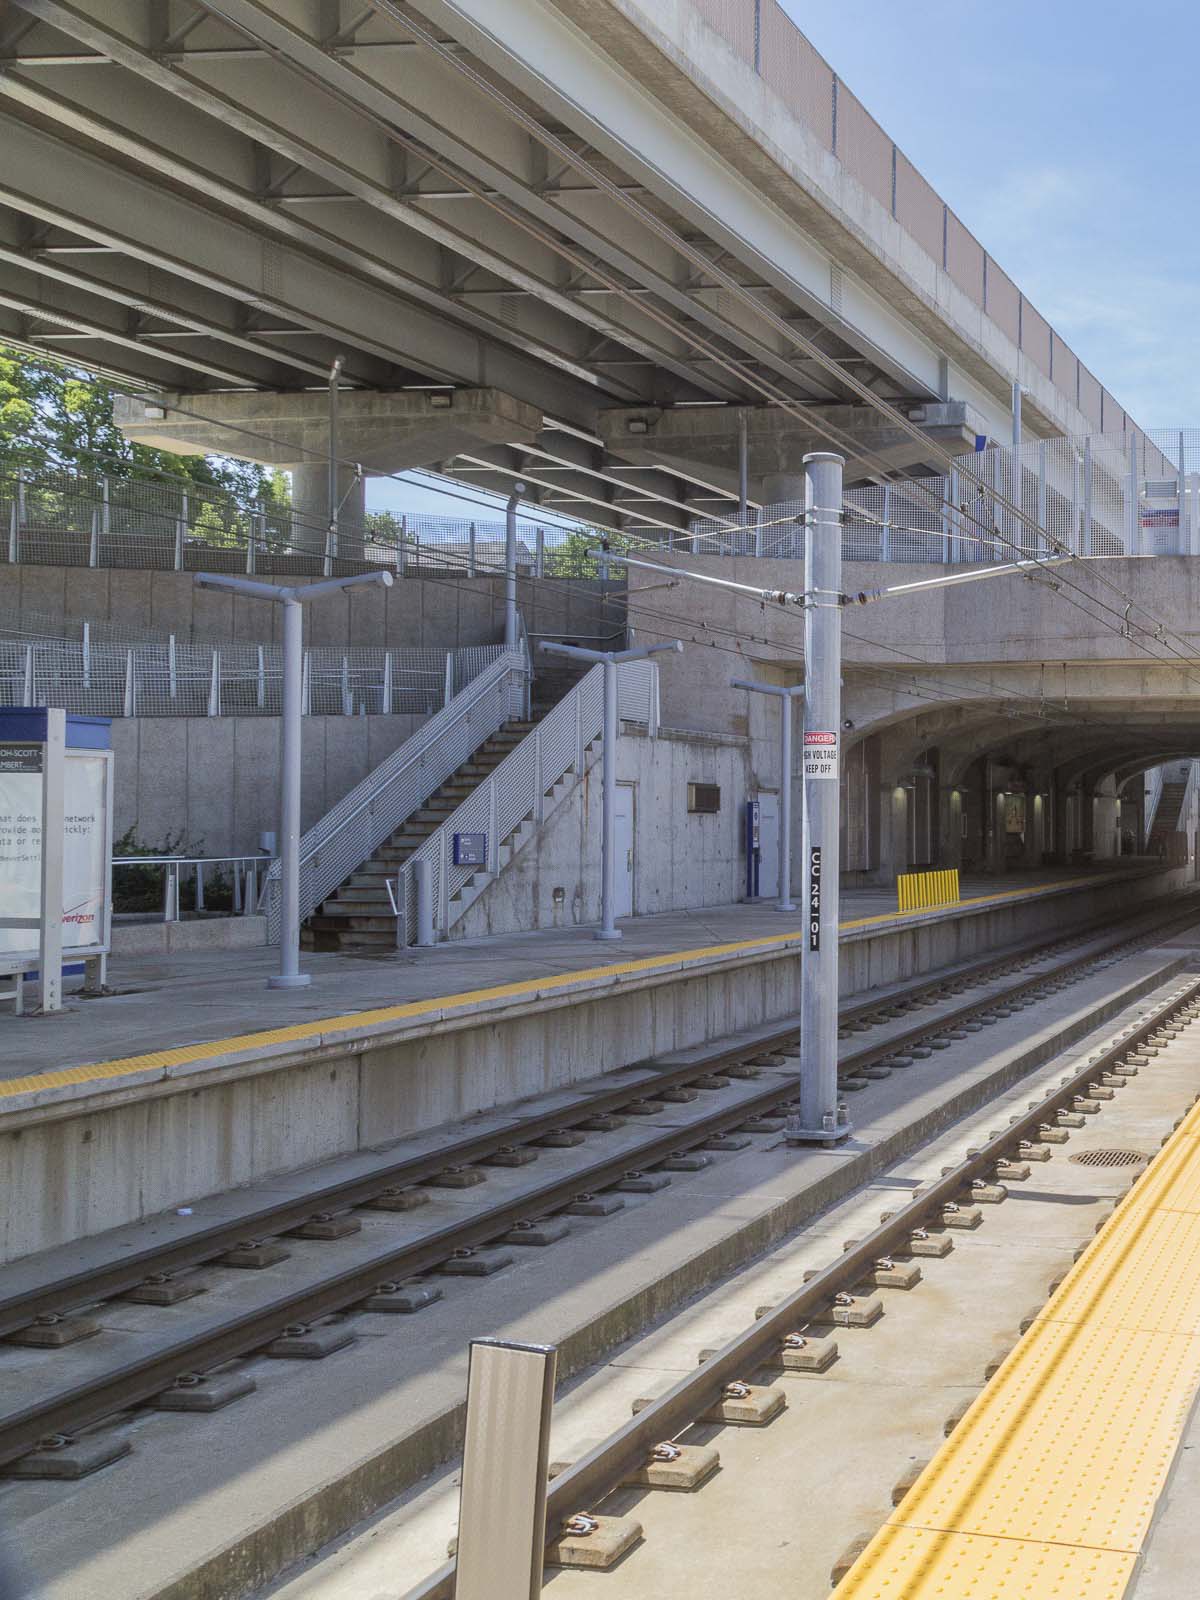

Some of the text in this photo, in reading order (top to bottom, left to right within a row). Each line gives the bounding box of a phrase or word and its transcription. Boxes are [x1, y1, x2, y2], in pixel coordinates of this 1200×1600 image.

[812, 750, 837, 760] VOLTAGE
[820, 764, 832, 774] OFF
[62, 913, 95, 924] verizon
